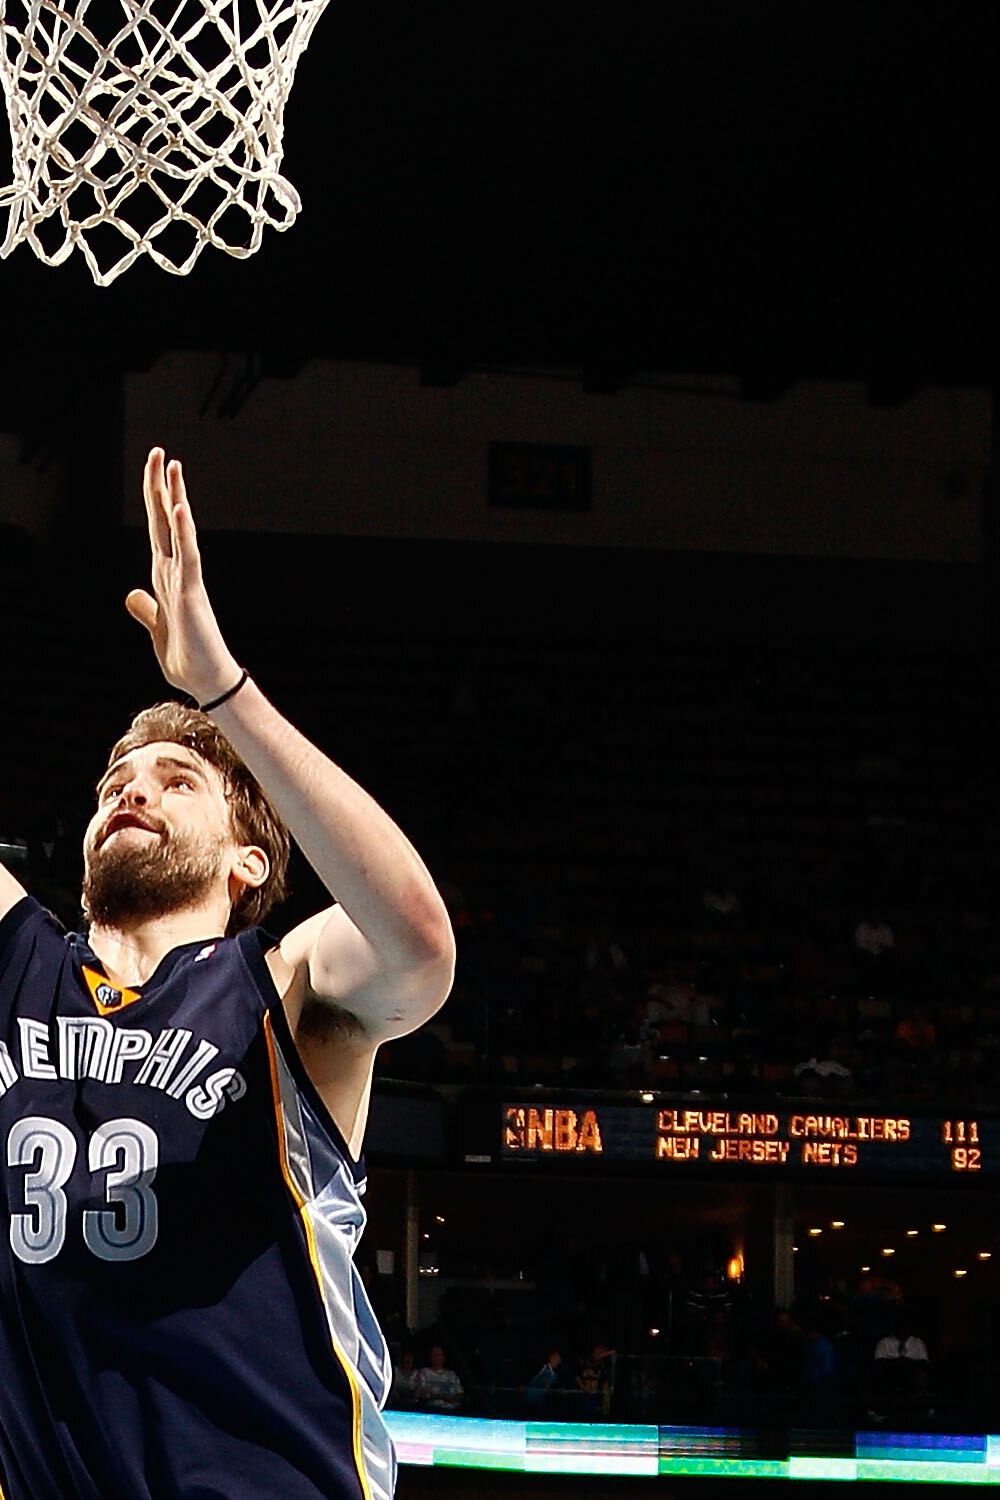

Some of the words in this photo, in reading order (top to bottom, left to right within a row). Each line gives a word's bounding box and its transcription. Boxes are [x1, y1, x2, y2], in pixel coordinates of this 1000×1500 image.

[503, 457, 577, 497] 321
[527, 1108, 602, 1151] NBA
[658, 1110, 779, 1134] CLEVELAND
[791, 1116, 910, 1140] CAVALIERS
[943, 1121, 979, 1142] 111
[658, 1137, 699, 1159] NEW
[711, 1139, 791, 1162] JERSEY
[804, 1143, 858, 1164] NETS
[954, 1148, 982, 1169] 92
[7, 1116, 159, 1264] 33
